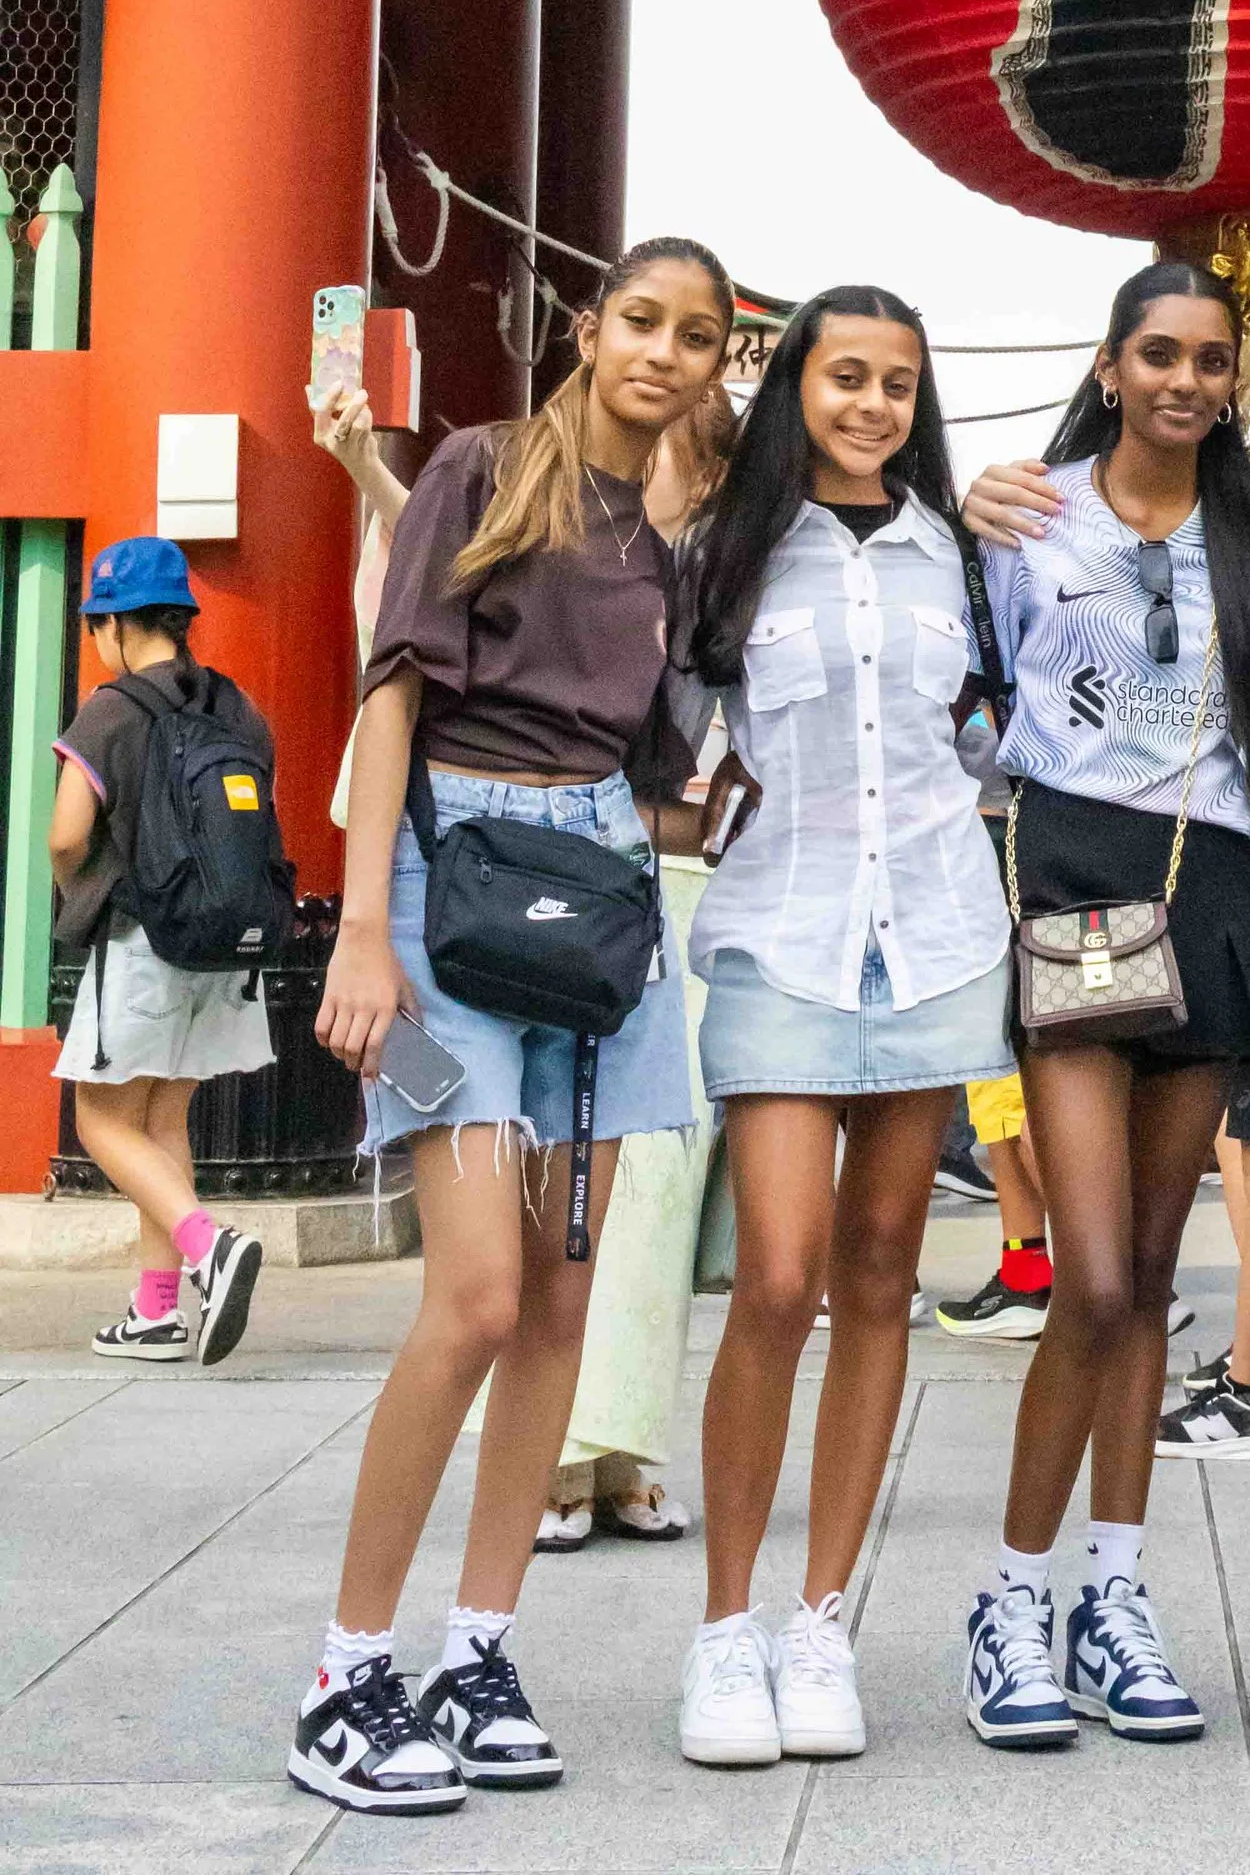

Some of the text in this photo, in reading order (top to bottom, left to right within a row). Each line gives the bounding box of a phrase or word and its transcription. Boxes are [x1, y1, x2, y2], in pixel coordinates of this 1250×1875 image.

[978, 617, 992, 649] lein
[1117, 702, 1229, 730] charteed
[534, 896, 570, 914] NIKE
[580, 1092, 591, 1129] LEARN
[573, 1174, 586, 1226] EXPLORE
